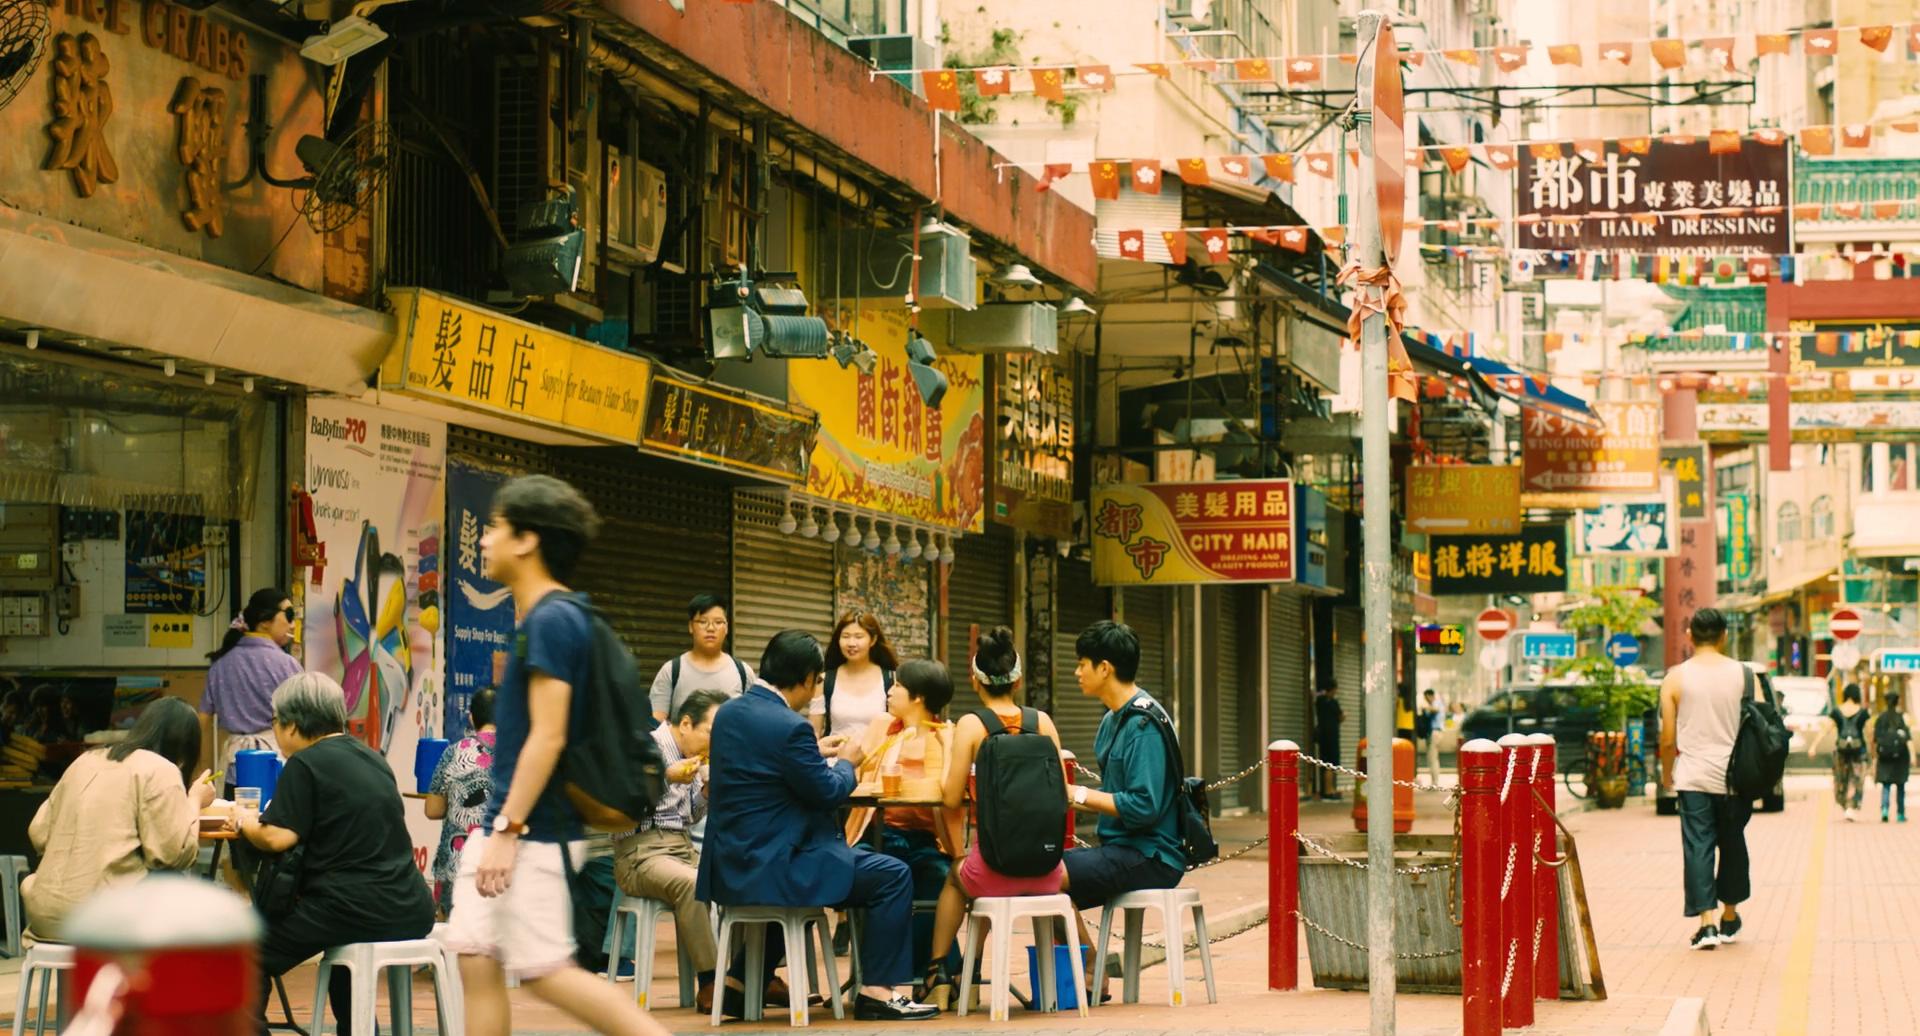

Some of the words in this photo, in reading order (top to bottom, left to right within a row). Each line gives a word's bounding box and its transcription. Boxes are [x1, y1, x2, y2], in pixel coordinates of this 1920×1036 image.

[141, 2, 250, 81] CRABS
[1529, 152, 1641, 210] 都市
[1531, 220, 1583, 238] CITY
[1601, 219, 1656, 237] HAIR
[1671, 217, 1776, 237] DRESSING
[430, 309, 536, 412] 髮品店
[1527, 437, 1560, 450] WING
[1566, 437, 1600, 450] HING
[1176, 490, 1288, 518] 美髮用品
[1095, 498, 1171, 580] 都市
[1190, 533, 1234, 552] CITY
[1242, 532, 1288, 551] HAIR
[1262, 553, 1281, 561] AND
[1434, 540, 1565, 578] 龍將洋服
[454, 624, 471, 643] Supply
[471, 626, 484, 644] Shop
